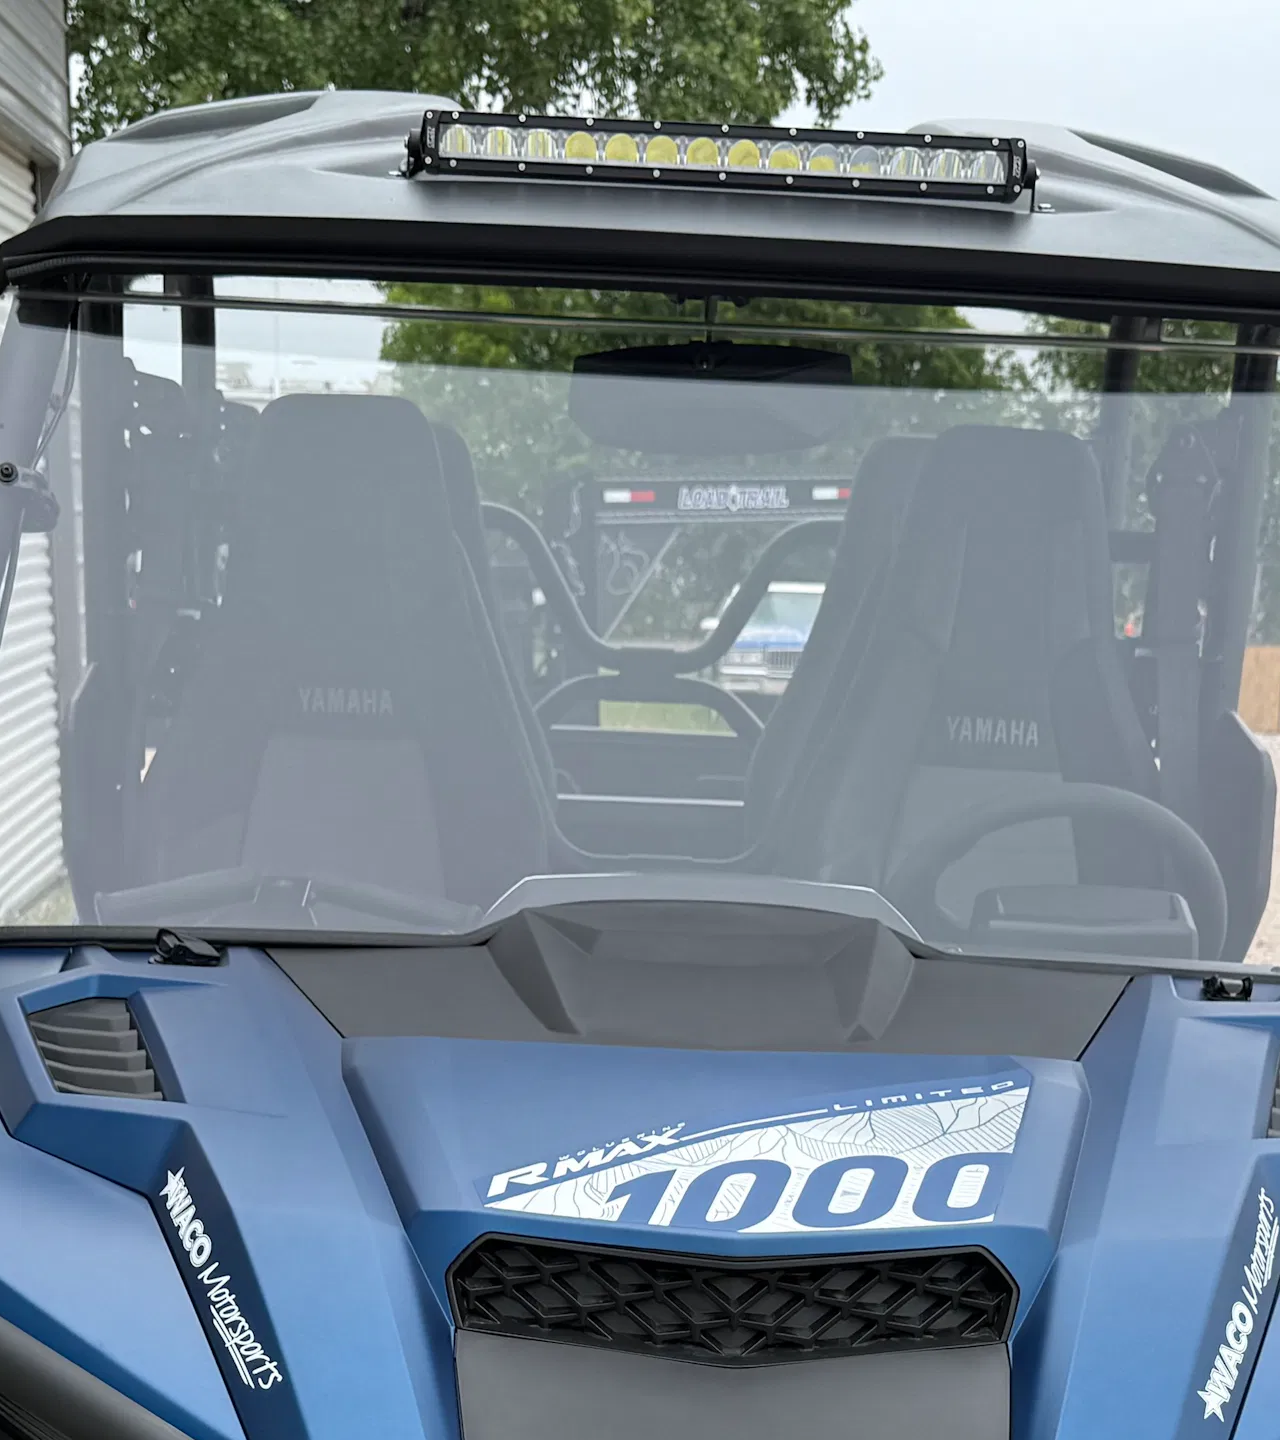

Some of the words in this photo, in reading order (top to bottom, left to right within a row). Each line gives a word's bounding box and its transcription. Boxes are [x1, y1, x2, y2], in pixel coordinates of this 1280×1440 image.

[298, 687, 394, 716] YAMAHA
[946, 715, 1038, 748] YAMAHA
[833, 1080, 1014, 1111] LIMITED
[487, 1127, 682, 1197] RMAX
[605, 1152, 1013, 1229] 1000
[166, 1176, 213, 1268] WACO
[197, 1261, 283, 1390] Motorsports
[1205, 1301, 1254, 1402] WACO
